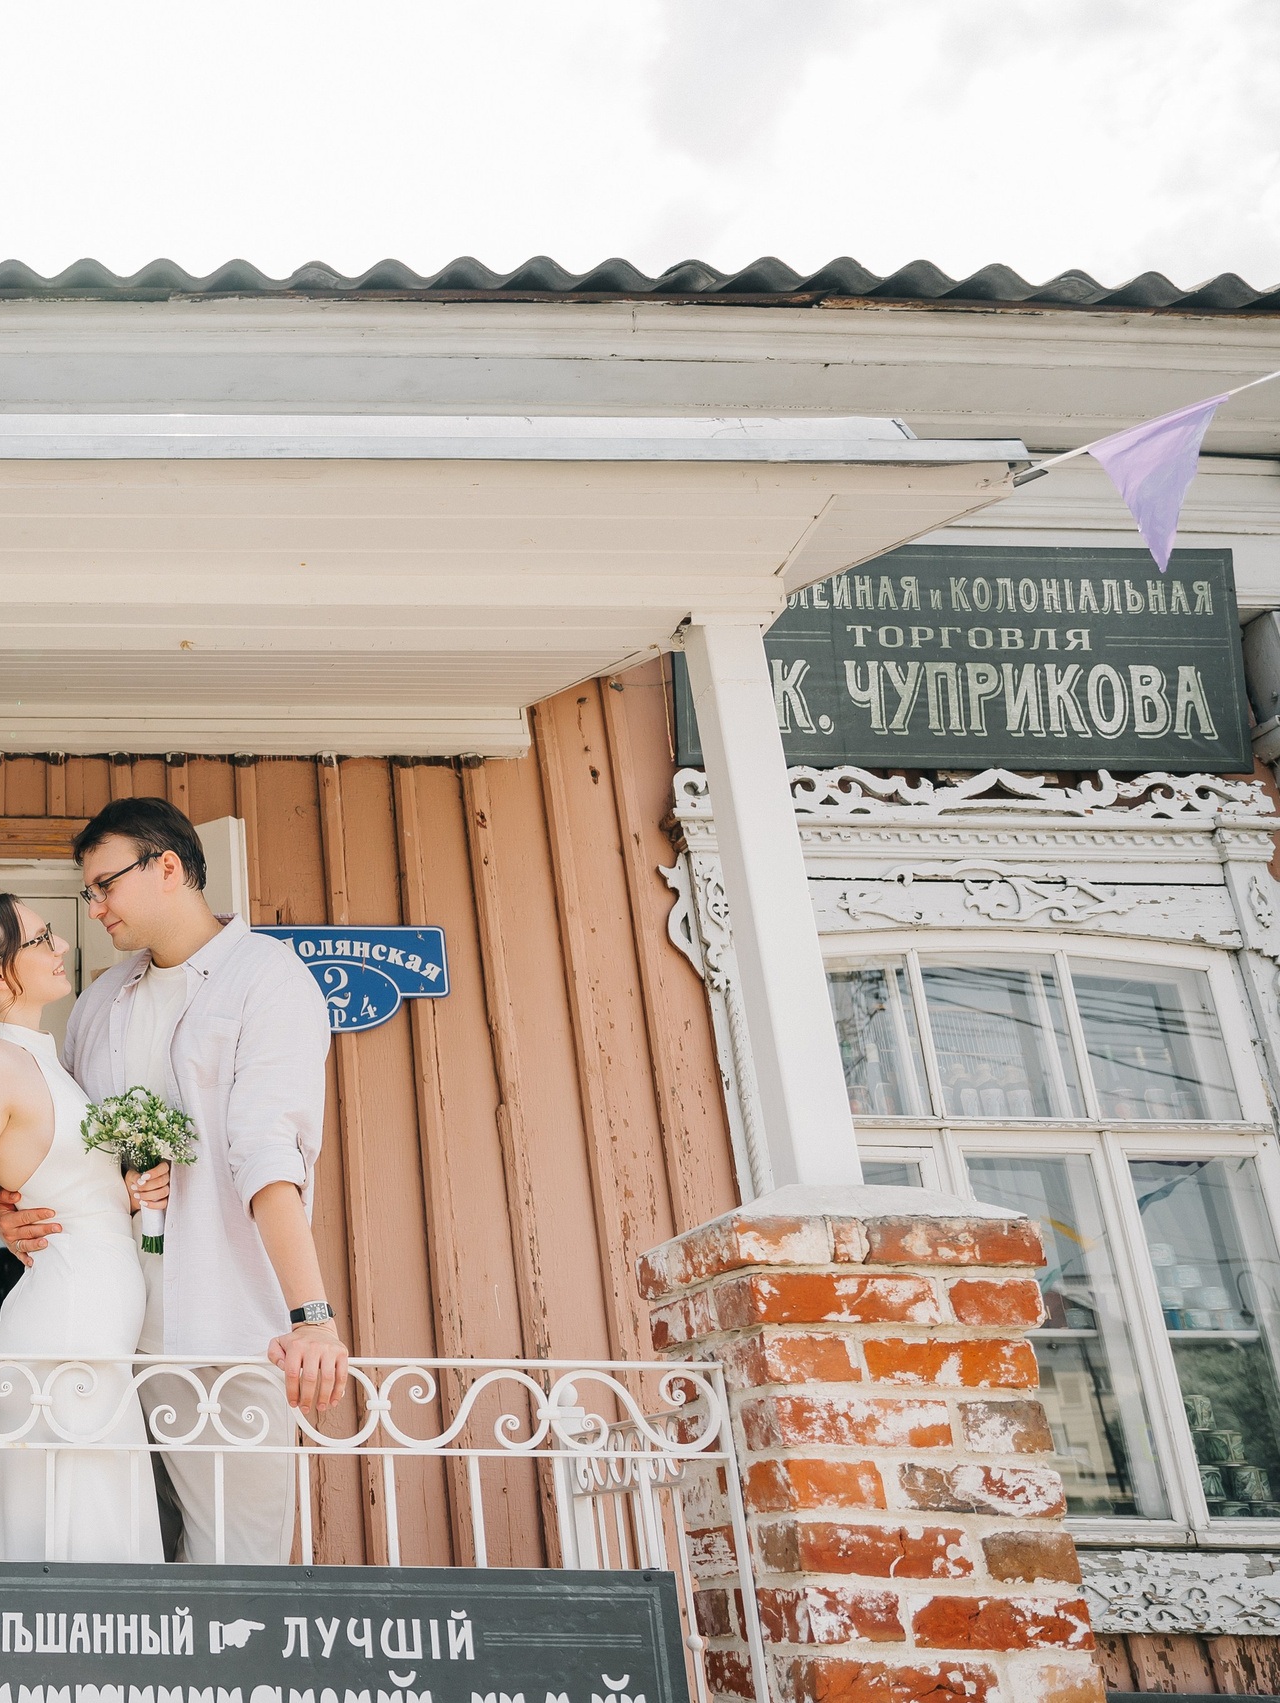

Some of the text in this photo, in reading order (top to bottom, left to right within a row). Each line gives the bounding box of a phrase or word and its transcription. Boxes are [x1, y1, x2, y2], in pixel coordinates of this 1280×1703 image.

[788, 571, 921, 611] ЛЕЙНАЯ
[950, 577, 1214, 616] КОЛОНІАЛЬНАЯ
[846, 624, 1092, 651] ТОРГОВЛЯ
[844, 658, 1219, 741] ЧУПРИКОВА
